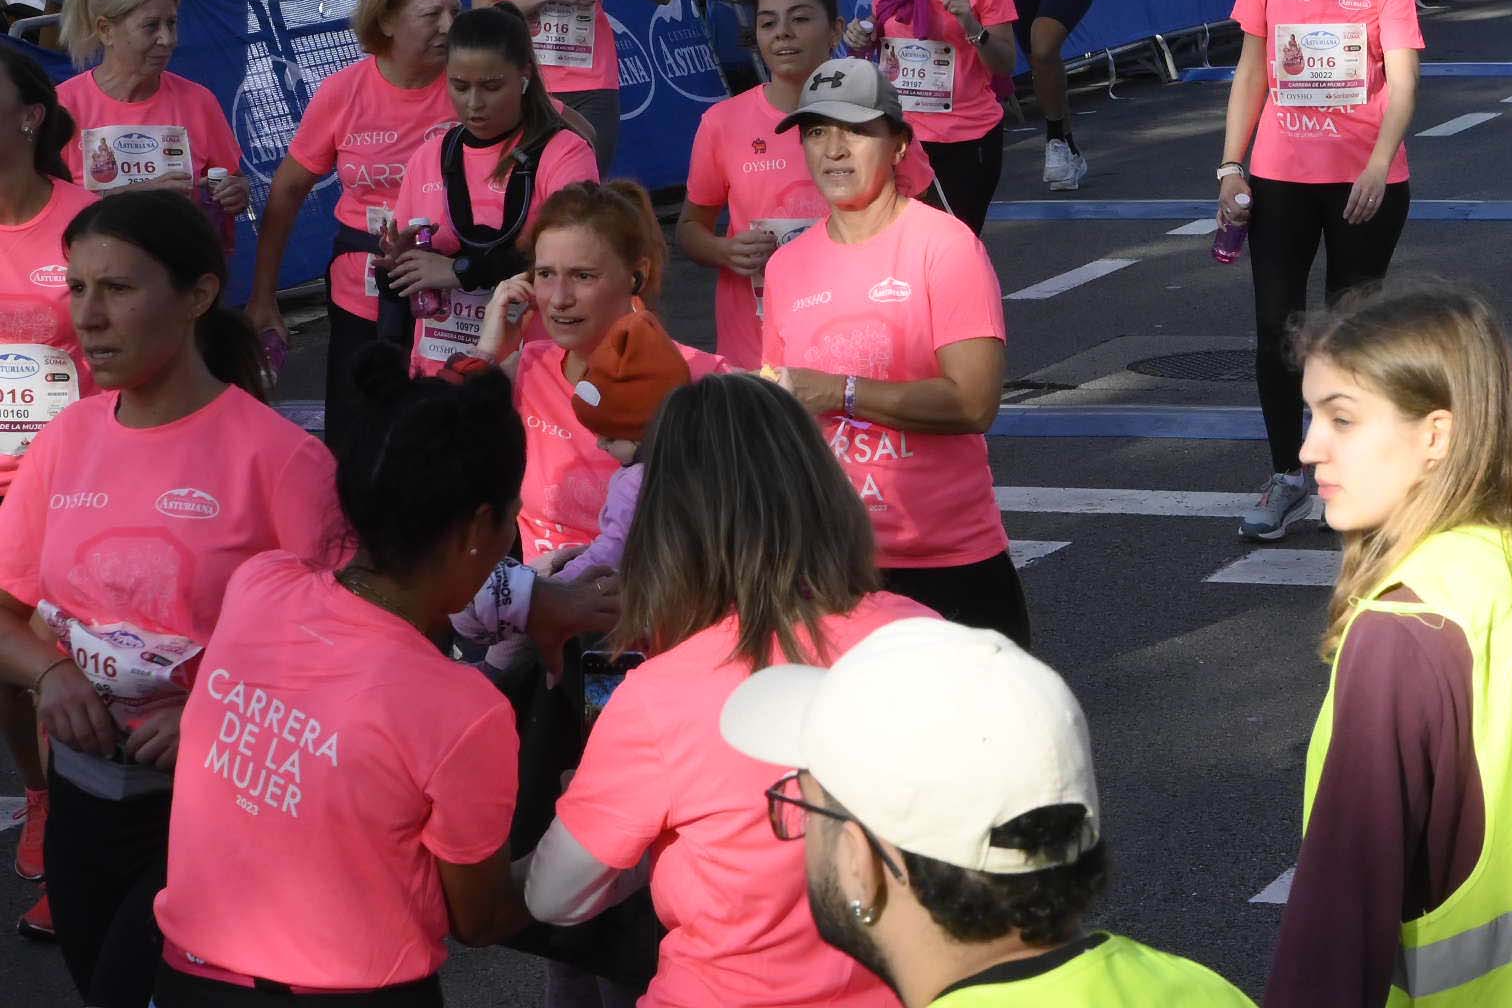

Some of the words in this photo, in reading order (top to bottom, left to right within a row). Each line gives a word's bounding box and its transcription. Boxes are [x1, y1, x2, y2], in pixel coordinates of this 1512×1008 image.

[543, 22, 569, 33] 016
[1307, 57, 1336, 68] 016
[901, 67, 926, 78] 016
[1310, 71, 1333, 79] 30022
[342, 130, 399, 147] OYSHO
[120, 161, 156, 174] 016
[742, 158, 787, 174] OYSHO
[453, 302, 486, 320] 016
[455, 321, 480, 333] 10979
[159, 497, 214, 515] ASTURIANA
[76, 647, 117, 678] 016
[207, 666, 339, 768] CARRERA
[219, 710, 257, 757] DE
[264, 743, 302, 783] LA
[204, 739, 302, 819] MUJER
[235, 794, 260, 817] 2023
